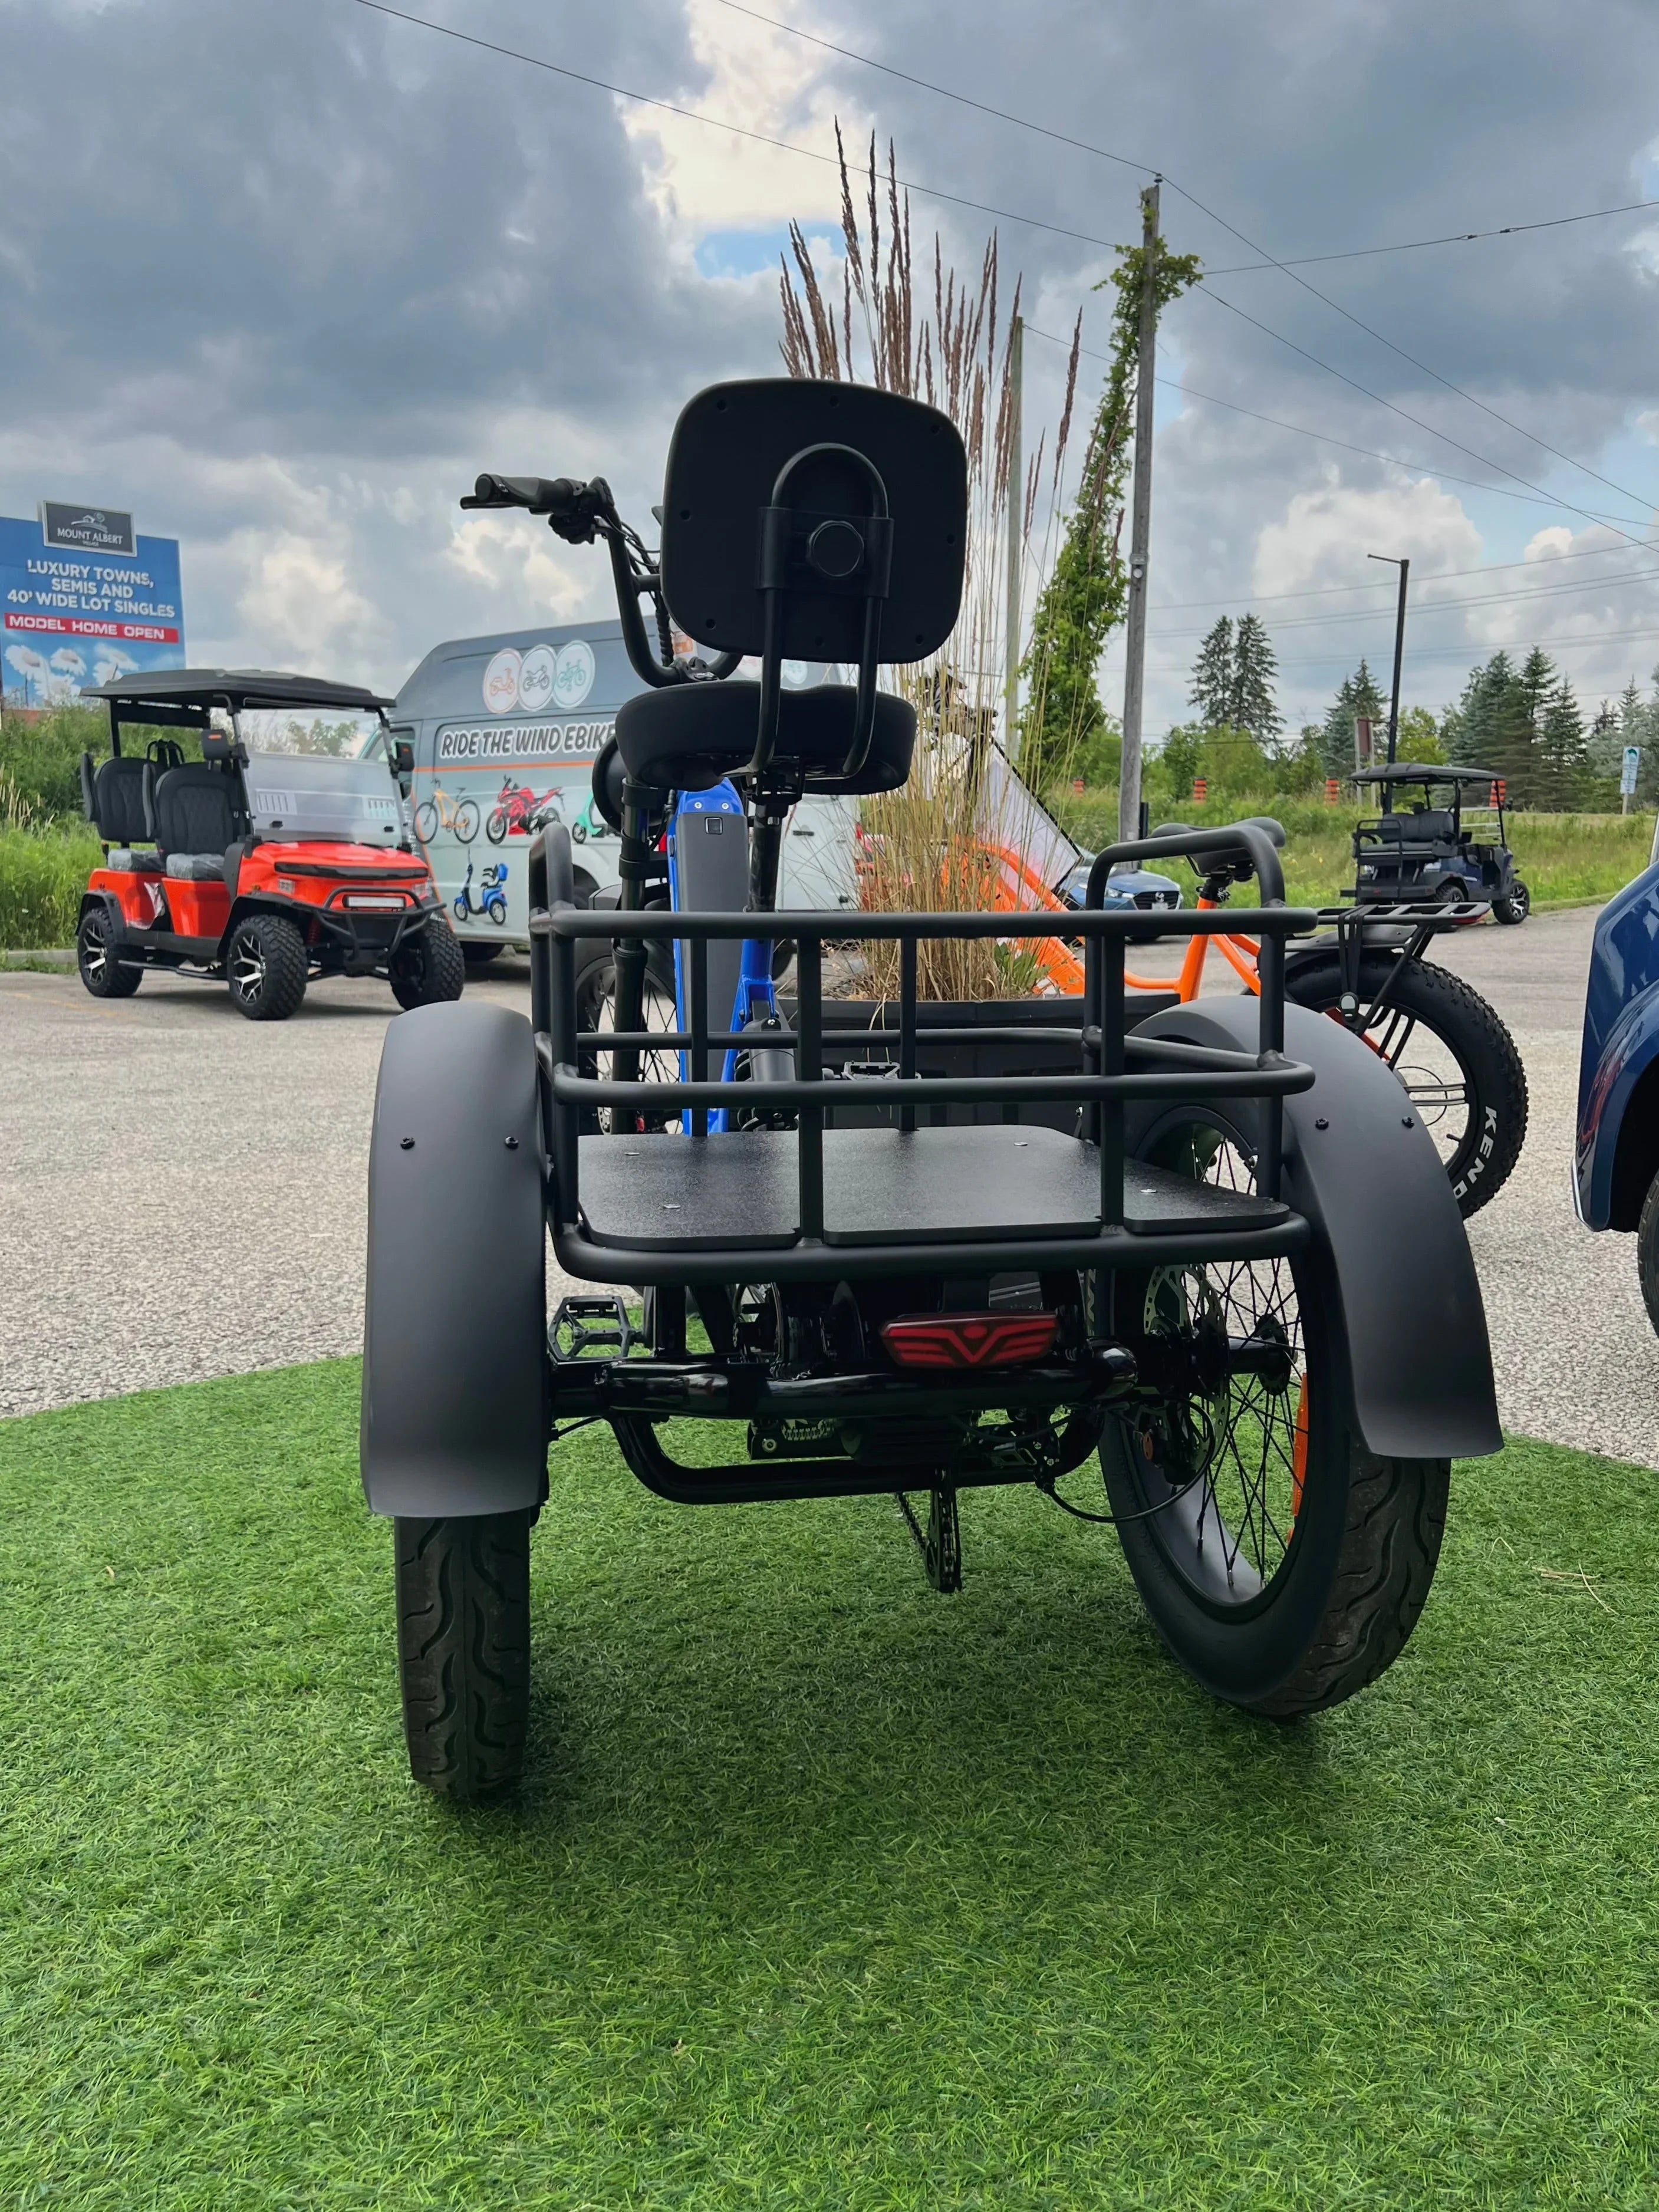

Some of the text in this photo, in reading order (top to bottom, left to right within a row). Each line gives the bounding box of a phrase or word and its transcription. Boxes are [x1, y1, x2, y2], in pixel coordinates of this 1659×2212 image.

[57, 528, 123, 545] MOUNT ALBERT
[28, 559, 154, 588] LUXURY TOWNS,
[51, 578, 133, 598] SEMIS AND
[7, 590, 175, 618] 40' WIDE LOT SINGLES
[9, 615, 164, 640] MODEL HOME OPEN
[440, 731, 480, 758] RIDE
[481, 729, 515, 756] THE
[515, 726, 562, 754] WIND
